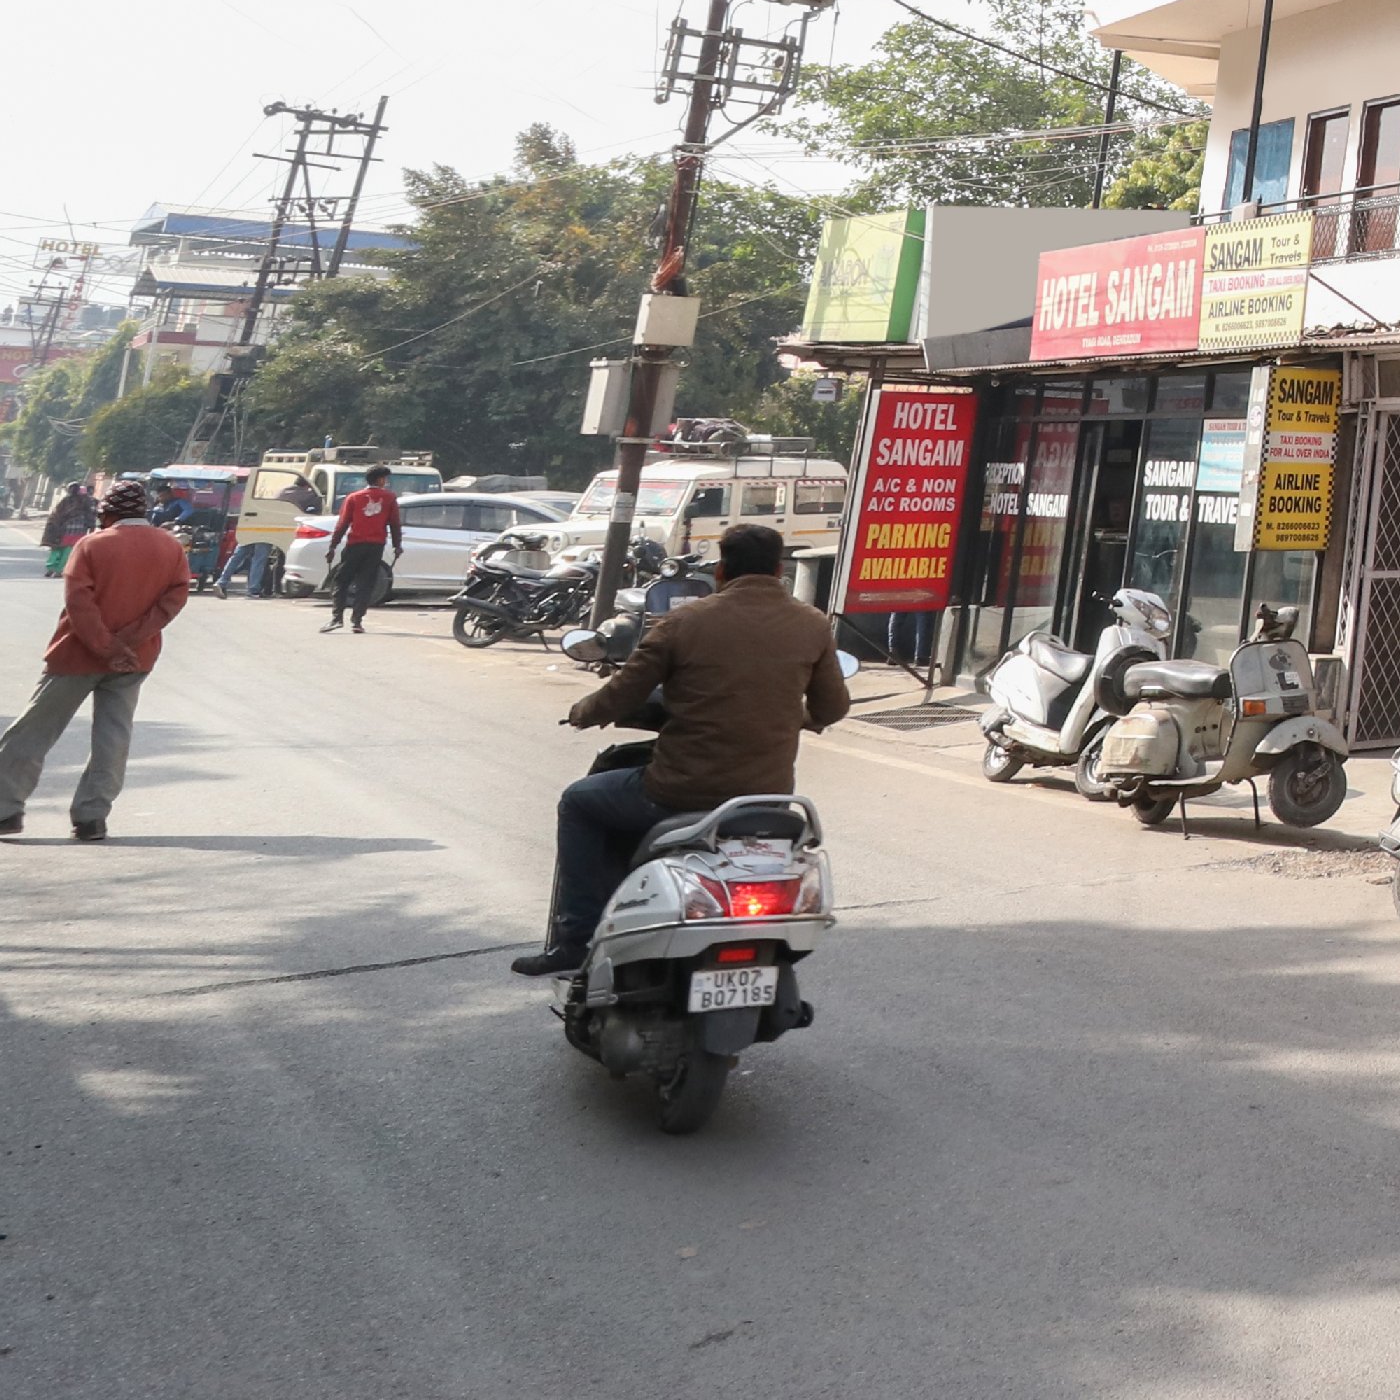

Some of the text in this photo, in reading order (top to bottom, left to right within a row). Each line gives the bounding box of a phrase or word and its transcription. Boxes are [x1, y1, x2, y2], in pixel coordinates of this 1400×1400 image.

[42, 240, 103, 255] HOTEL
[1210, 238, 1263, 270] SANGAM
[1271, 237, 1290, 248] Tour
[1293, 234, 1299, 245] &
[1270, 251, 1301, 264] Travels
[1208, 279, 1225, 293] TAXI
[1227, 274, 1265, 291] BOOKING
[1039, 258, 1197, 332] HOTEL SANGAM
[1208, 294, 1293, 318] AIRLINE BOOKING
[1277, 378, 1334, 406] SANGAM
[893, 402, 958, 431] HOTEL
[1277, 409, 1330, 423] Tour & Travels
[1280, 435, 1322, 446] TAXI BOOKING
[876, 438, 964, 467] SANGAM
[1270, 448, 1329, 459] FOR ALL OVER INDIA
[1144, 461, 1195, 487] SANGAM
[1274, 474, 1320, 490] AIRLINE
[873, 478, 956, 493] A/C & NON
[867, 497, 956, 512] A/C ROOMS
[990, 492, 1069, 517] HOTEL SANGAM
[1145, 495, 1177, 521] TOUR
[1178, 497, 1189, 521] &
[1269, 496, 1321, 513] BOOKING
[865, 523, 952, 549] PARKING
[859, 557, 947, 580] AVAILABLE
[714, 969, 762, 988] UK07
